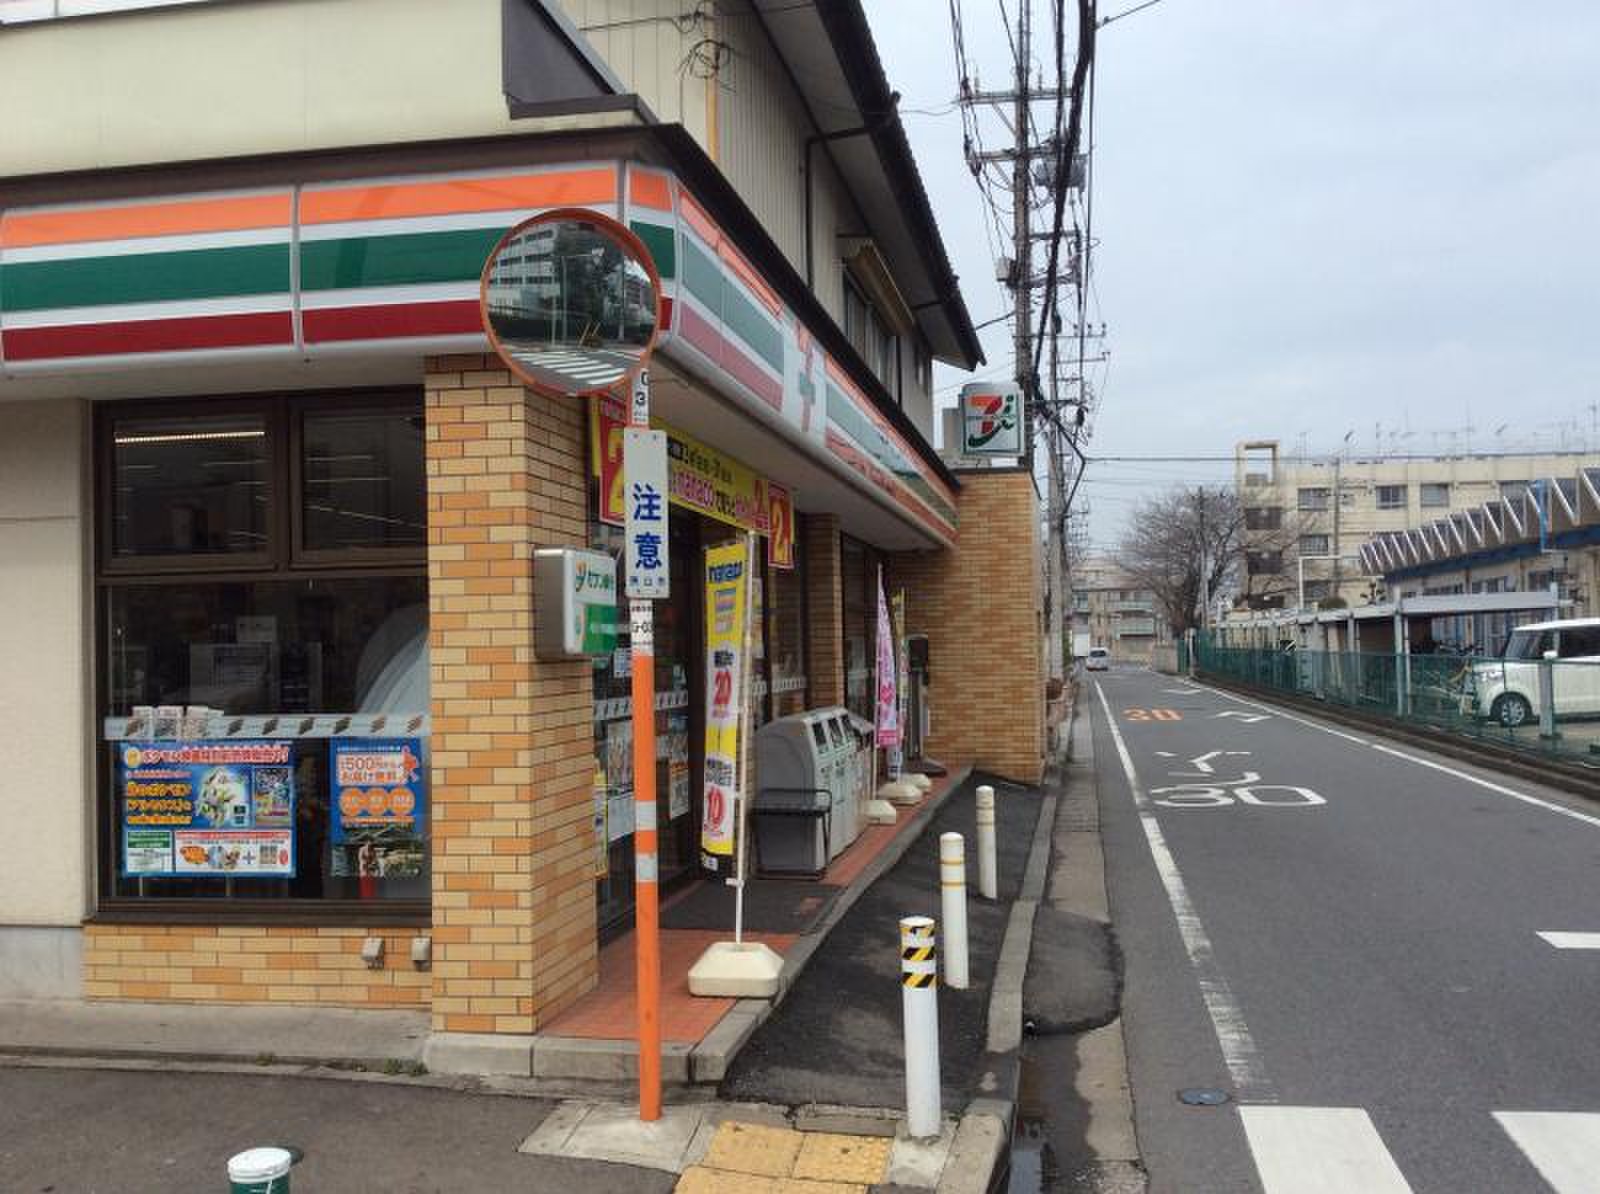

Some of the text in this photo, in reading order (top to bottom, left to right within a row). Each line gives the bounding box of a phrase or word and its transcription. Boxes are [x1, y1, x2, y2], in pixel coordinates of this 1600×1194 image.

[633, 482, 663, 570] 注意
[1123, 708, 1186, 721] 30
[1149, 784, 1327, 806] 30
